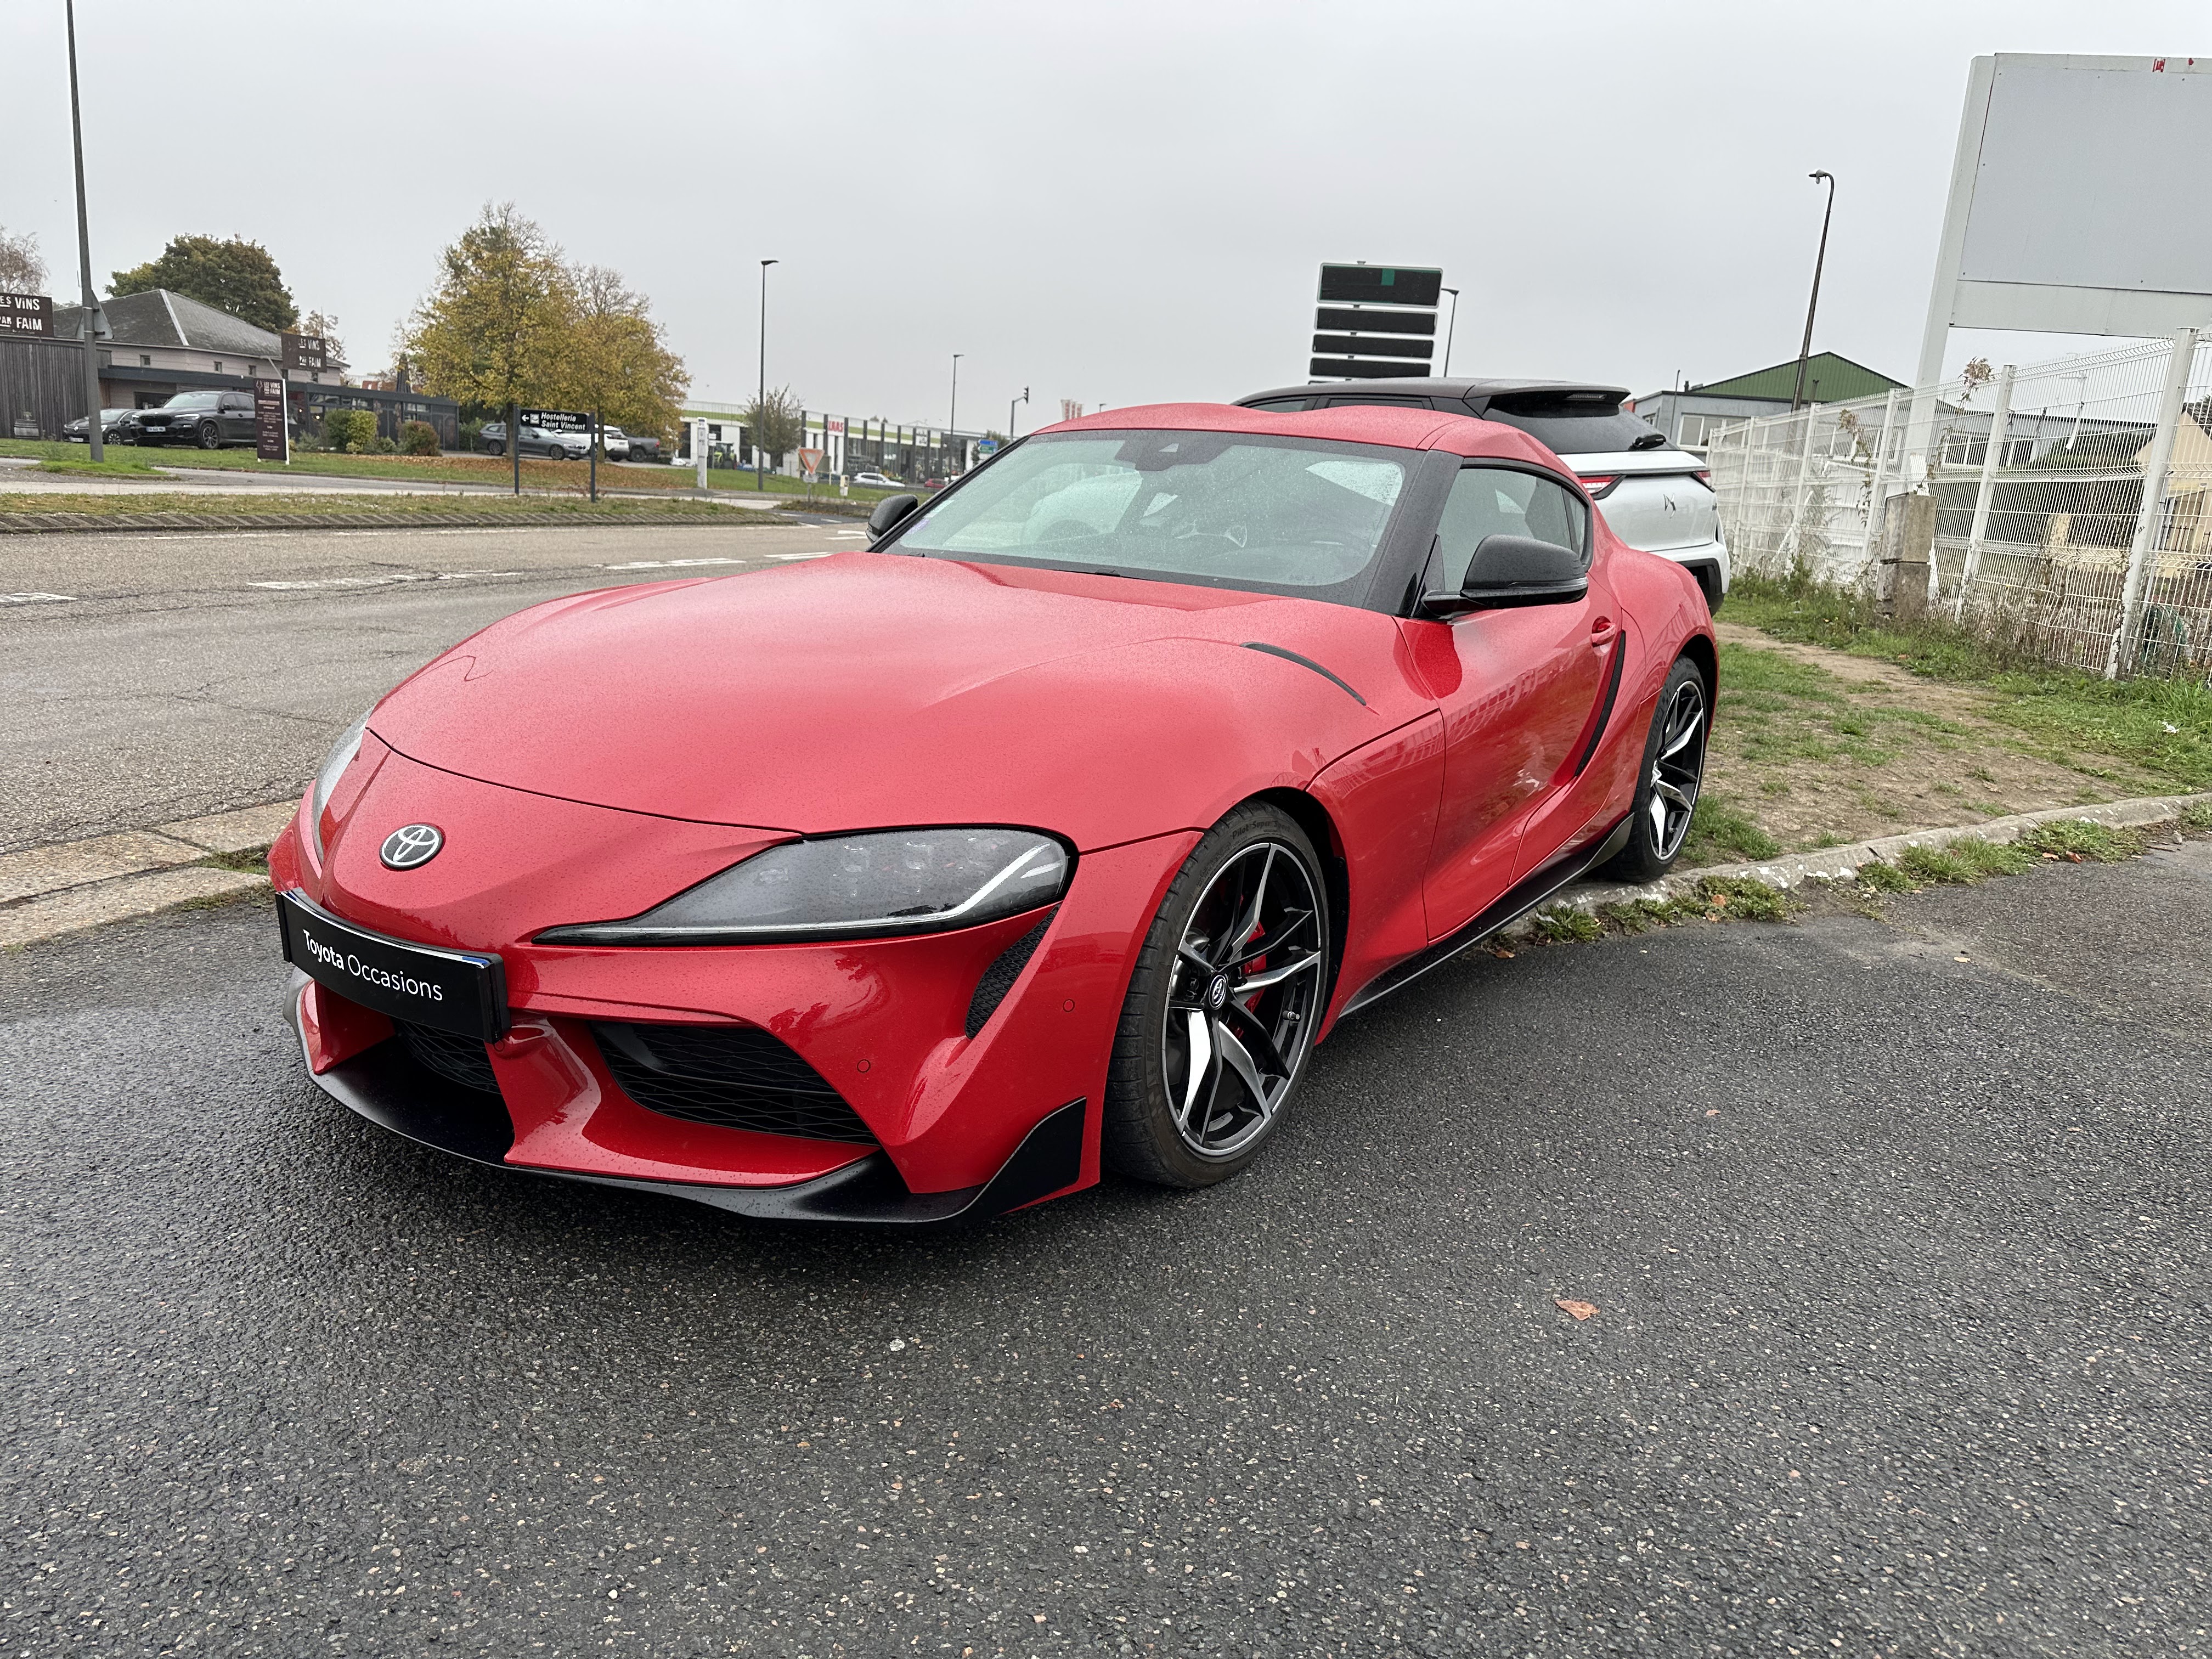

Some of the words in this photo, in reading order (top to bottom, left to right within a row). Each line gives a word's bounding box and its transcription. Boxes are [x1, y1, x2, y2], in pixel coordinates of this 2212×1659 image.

[0, 295, 12, 304] ES
[541, 412, 577, 422] Hostellerie
[541, 420, 559, 428] Saint
[561, 421, 586, 430] Vincent
[1231, 824, 1249, 839] Pilot
[303, 929, 345, 970] Toyota
[347, 955, 443, 1001] Occasions
